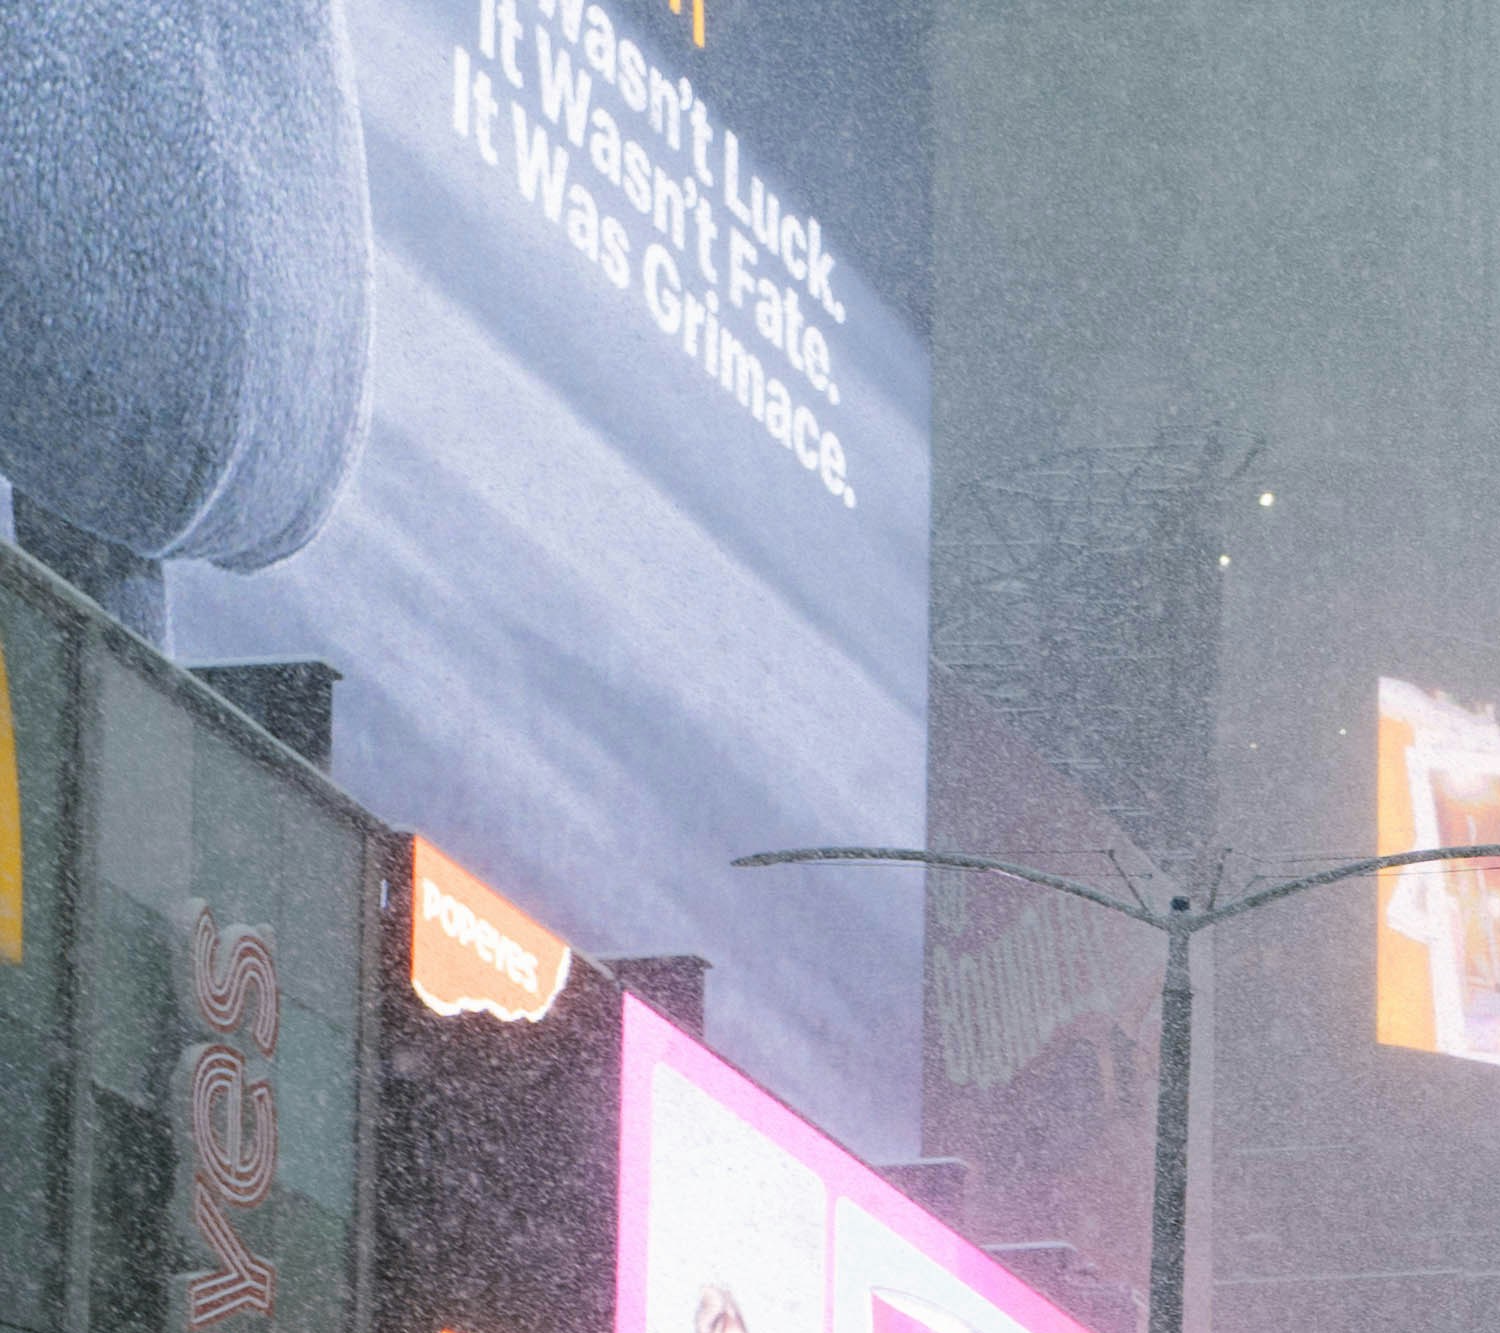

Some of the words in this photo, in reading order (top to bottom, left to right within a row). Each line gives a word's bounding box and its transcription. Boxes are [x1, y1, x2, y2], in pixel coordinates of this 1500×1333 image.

[454, 45, 499, 166] It
[511, 100, 631, 289] Was
[643, 242, 856, 508] Grimace.
[479, 0, 523, 88] It
[535, 24, 718, 283] Wasn't
[729, 228, 840, 405] Fate.
[538, 0, 713, 186] asn't
[725, 130, 846, 324] Luck.
[421, 874, 540, 994] POPEYES
